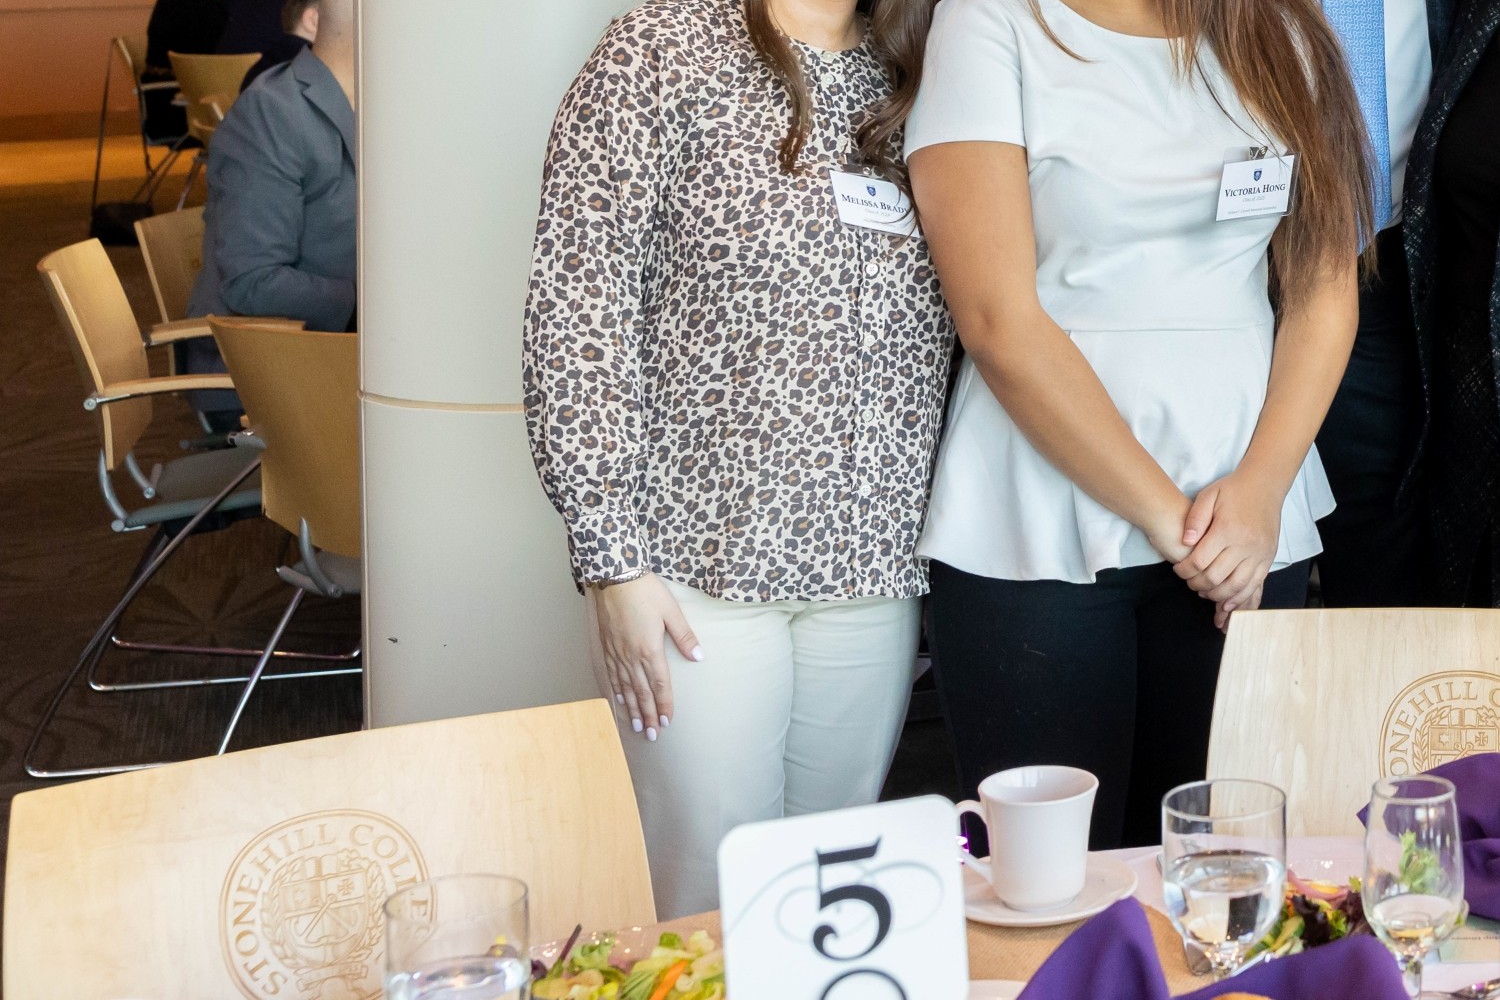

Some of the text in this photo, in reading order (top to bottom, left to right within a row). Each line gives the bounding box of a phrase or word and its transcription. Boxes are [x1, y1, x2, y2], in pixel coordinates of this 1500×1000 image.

[1225, 184, 1286, 197] VICTORIA HONG
[841, 194, 878, 209] MELISSA
[233, 823, 337, 997] STONEHILL
